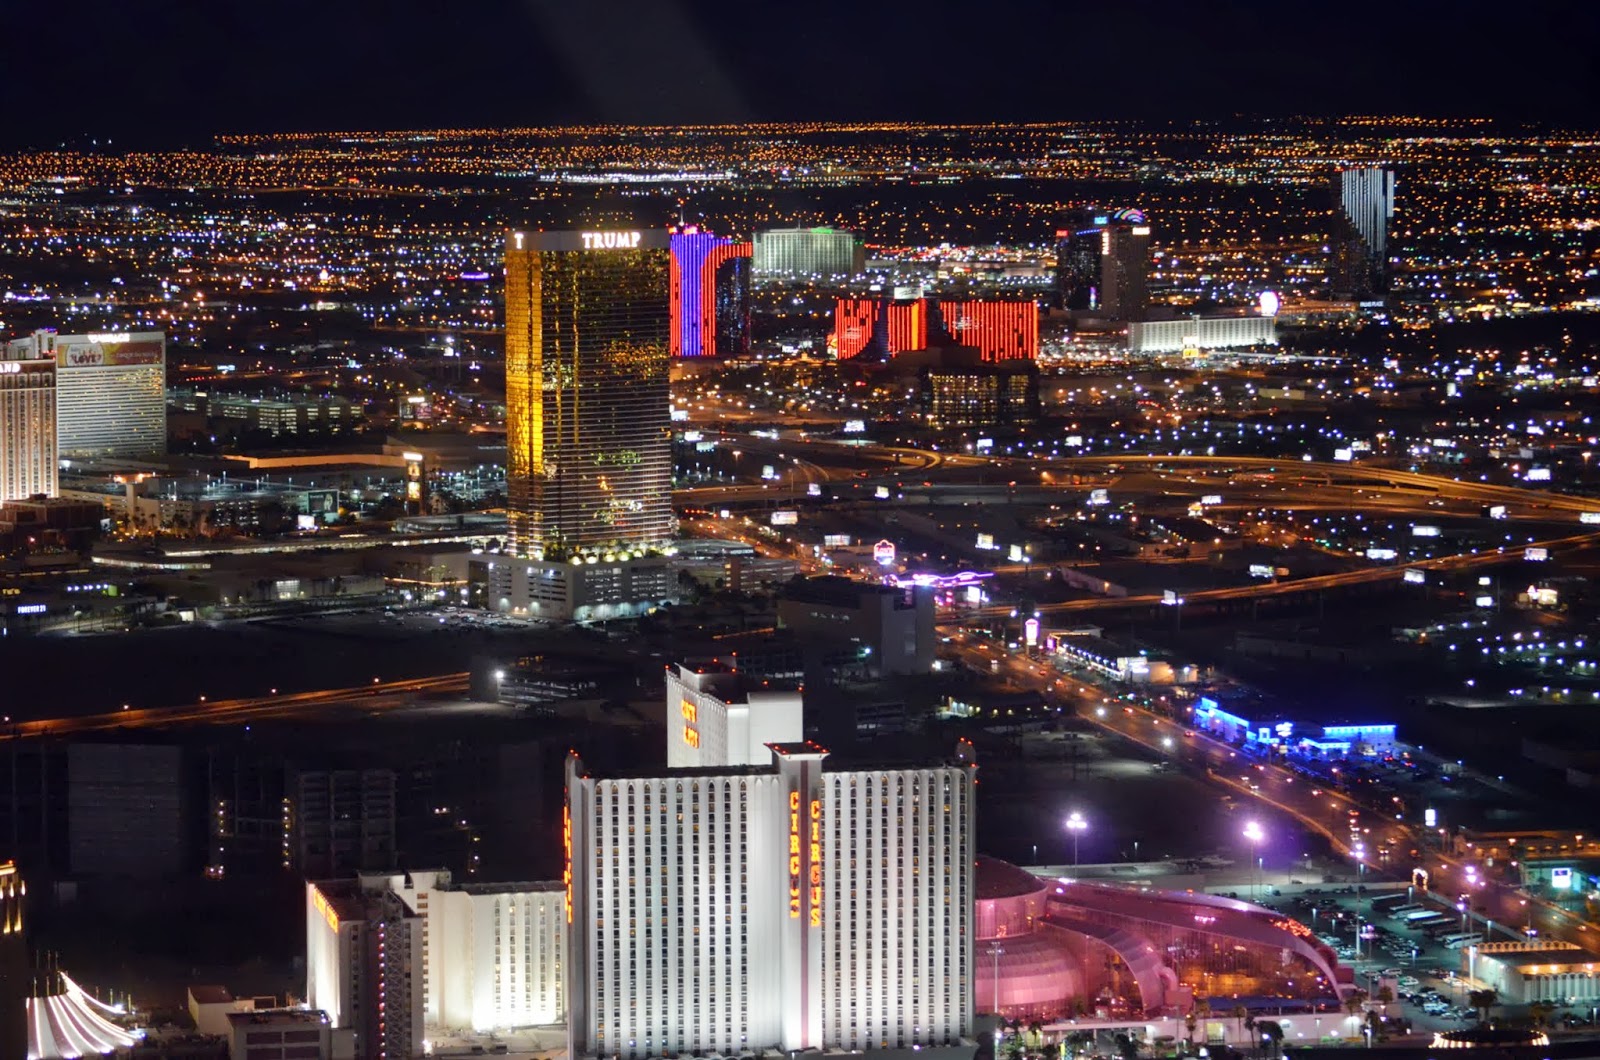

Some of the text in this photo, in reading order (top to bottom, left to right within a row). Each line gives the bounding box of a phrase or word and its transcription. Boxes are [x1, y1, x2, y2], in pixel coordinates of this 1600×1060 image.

[514, 232, 524, 249] T
[582, 231, 641, 249] TRUMP
[17, 604, 46, 614] FOREVER 21
[810, 800, 821, 928] CIRCUS
